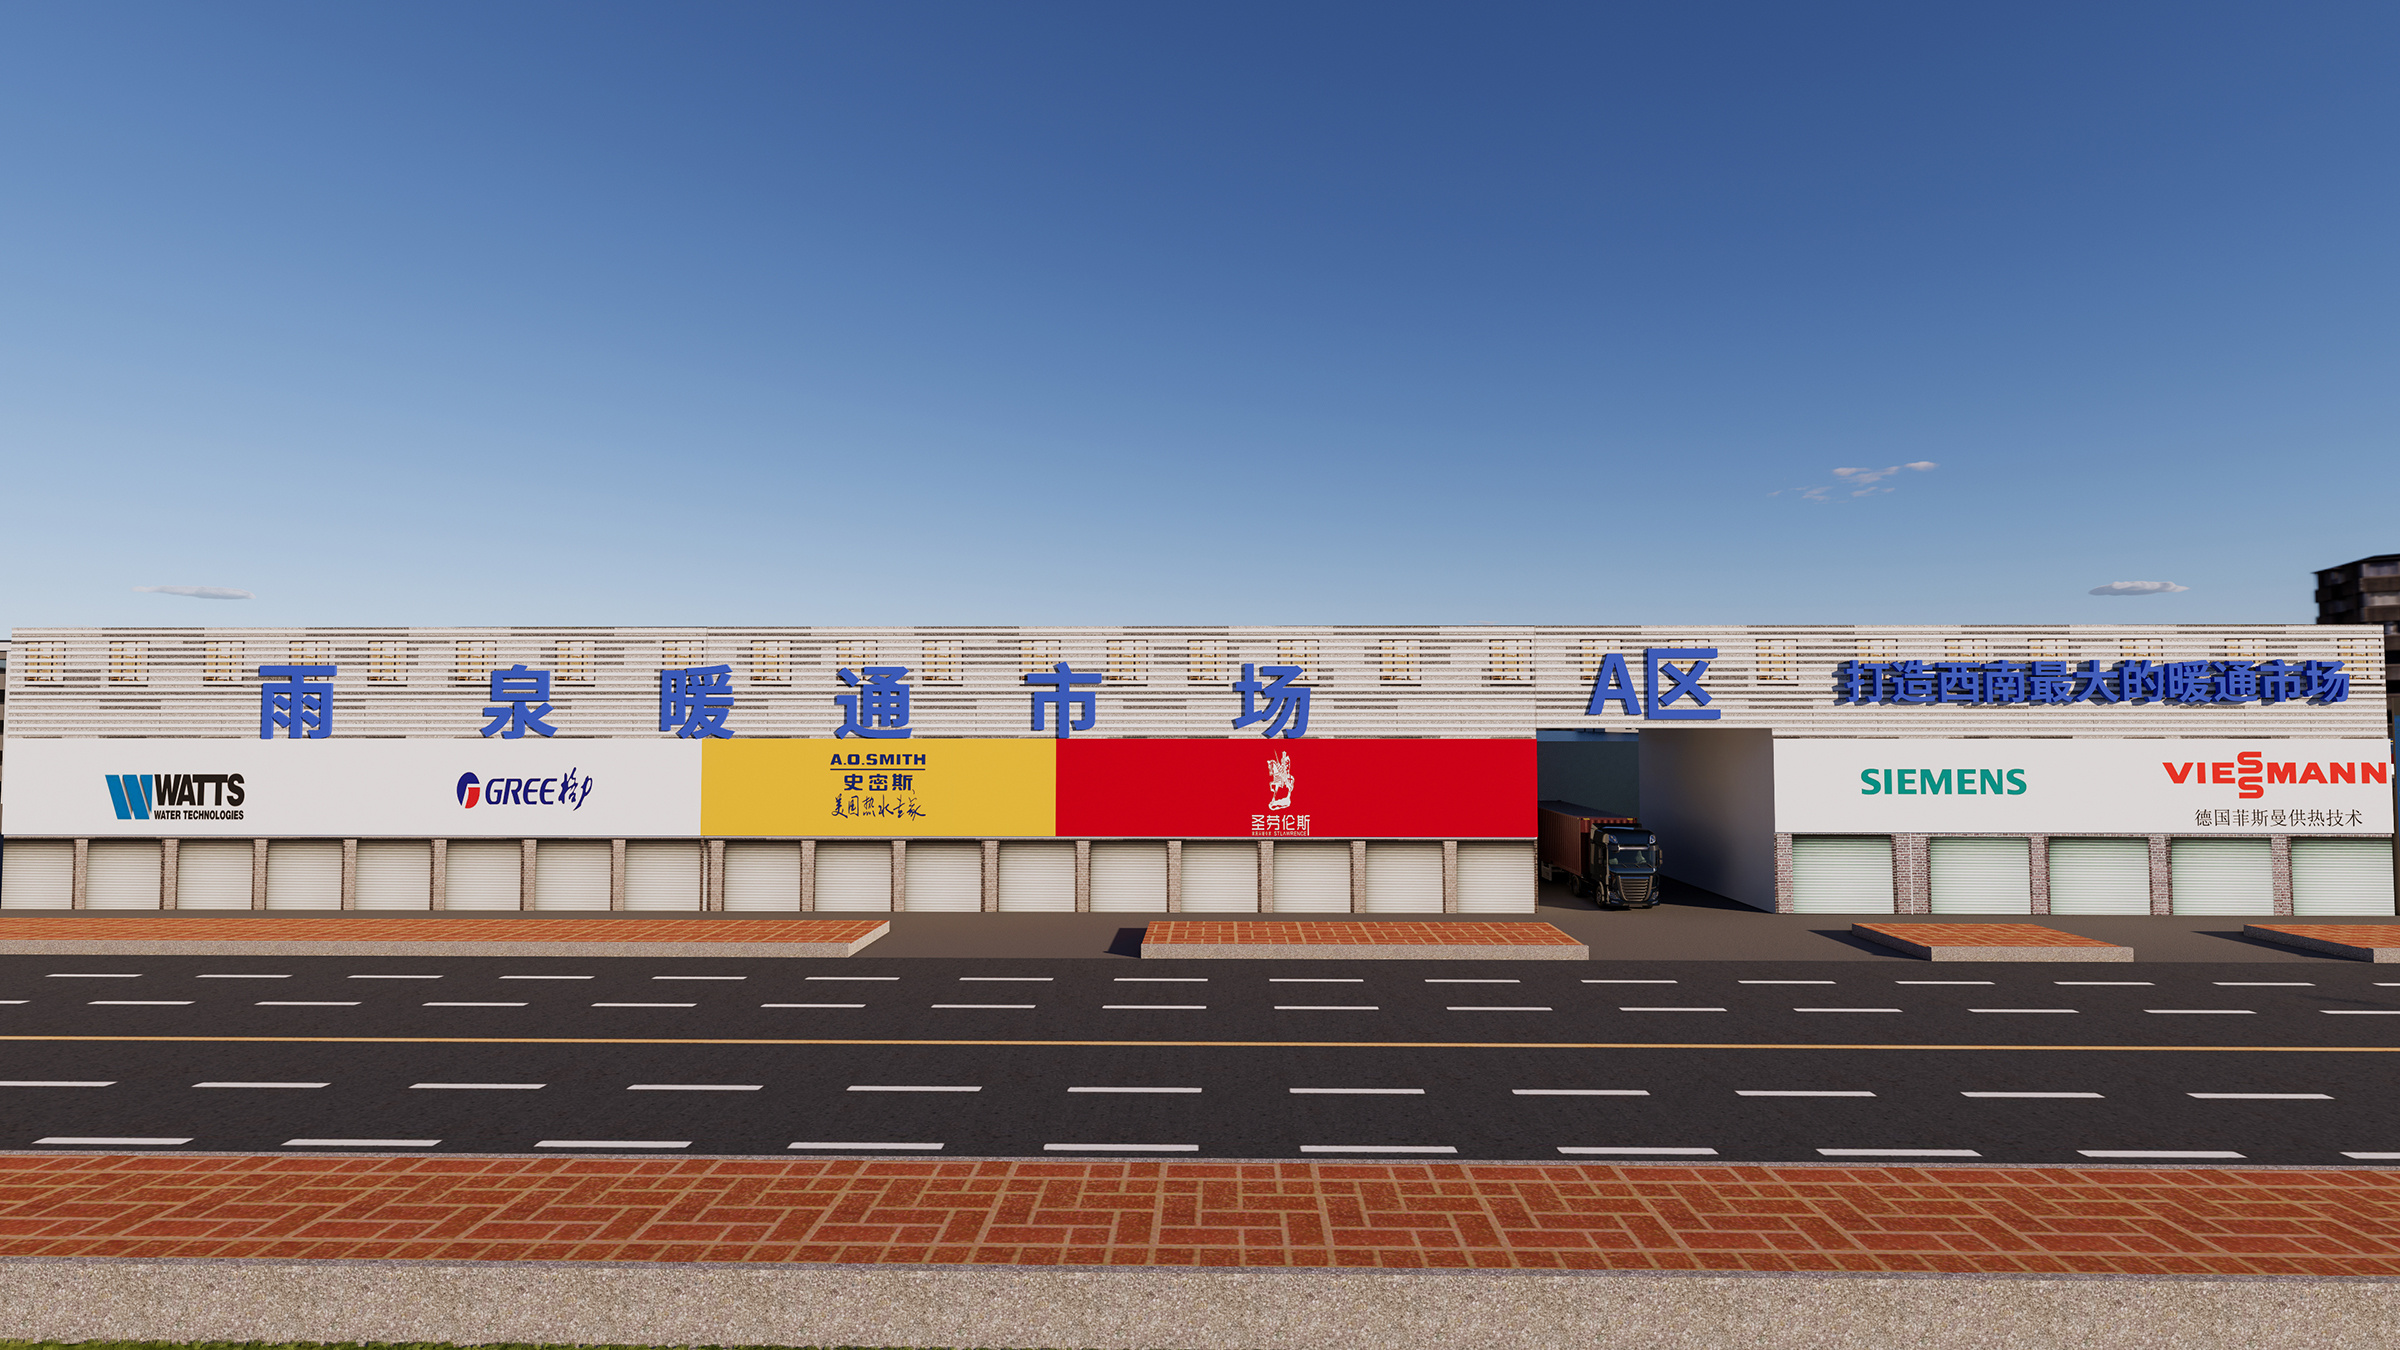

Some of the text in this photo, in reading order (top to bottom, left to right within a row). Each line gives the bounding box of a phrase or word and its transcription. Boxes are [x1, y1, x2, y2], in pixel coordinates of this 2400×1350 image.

[1844, 658, 2350, 704] 打造西南最大的暖通市场
[844, 773, 913, 791] 史密斯
[1861, 769, 2027, 796] SIEMENS
[2162, 751, 2388, 799] VIESSMANN
[154, 773, 245, 807] WATTS
[485, 778, 558, 805] GREE
[154, 810, 244, 820] WATER TECHNOLOGIES
[2195, 809, 2363, 827] 德国菲斯曼供热技术
